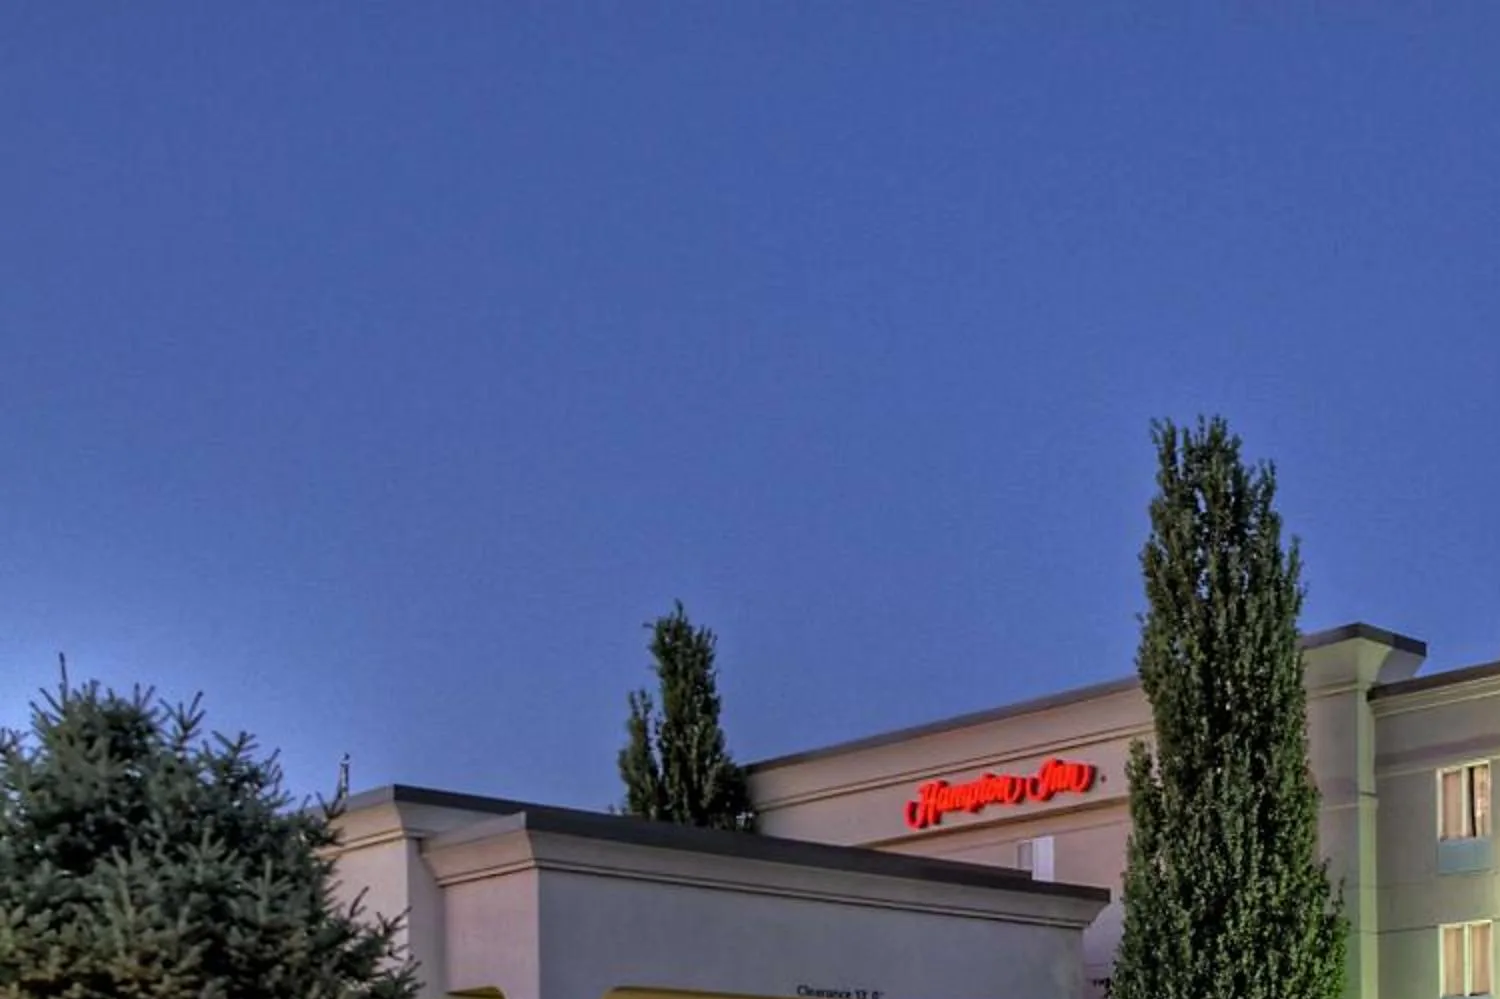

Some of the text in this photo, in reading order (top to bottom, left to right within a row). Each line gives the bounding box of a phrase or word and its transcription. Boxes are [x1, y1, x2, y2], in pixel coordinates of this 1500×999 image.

[905, 755, 1096, 831] Hampton Inn
[797, 985, 851, 999] Clearance
